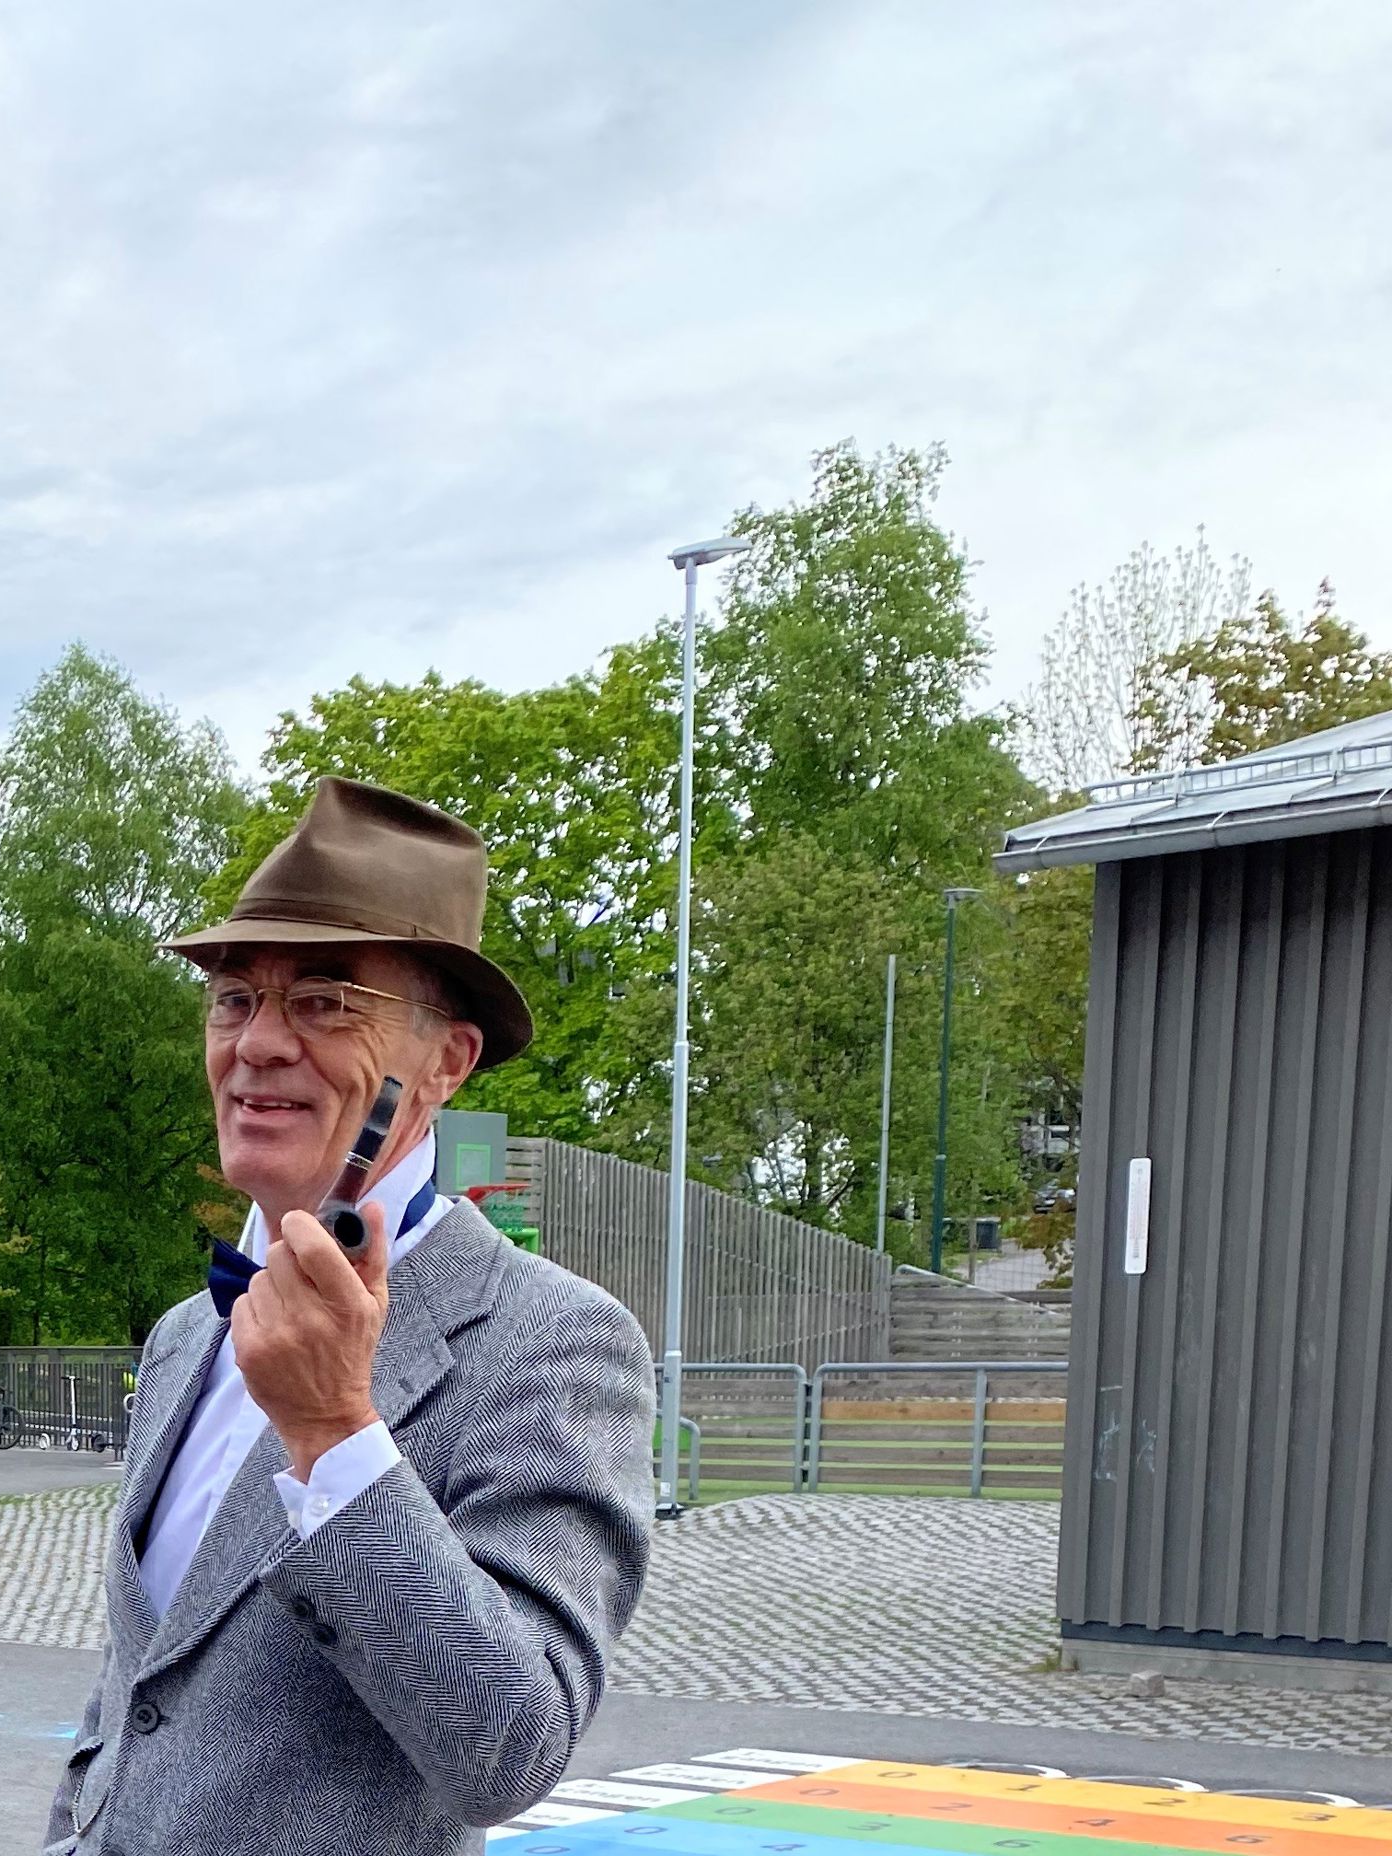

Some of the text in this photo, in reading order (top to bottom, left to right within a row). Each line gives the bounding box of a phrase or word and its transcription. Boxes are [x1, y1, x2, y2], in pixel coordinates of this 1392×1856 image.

[799, 1788, 1273, 1844] 0 2 4 6
[877, 1771, 917, 1779] 0
[1144, 1797, 1187, 1807] 2
[1293, 1813, 1337, 1821] 3
[624, 1826, 668, 1835] 0
[761, 1843, 806, 1852] 4
[715, 1806, 757, 1815] 0
[848, 1821, 893, 1831] 3
[992, 1839, 1041, 1848] 6
[524, 1845, 571, 1855] 0
